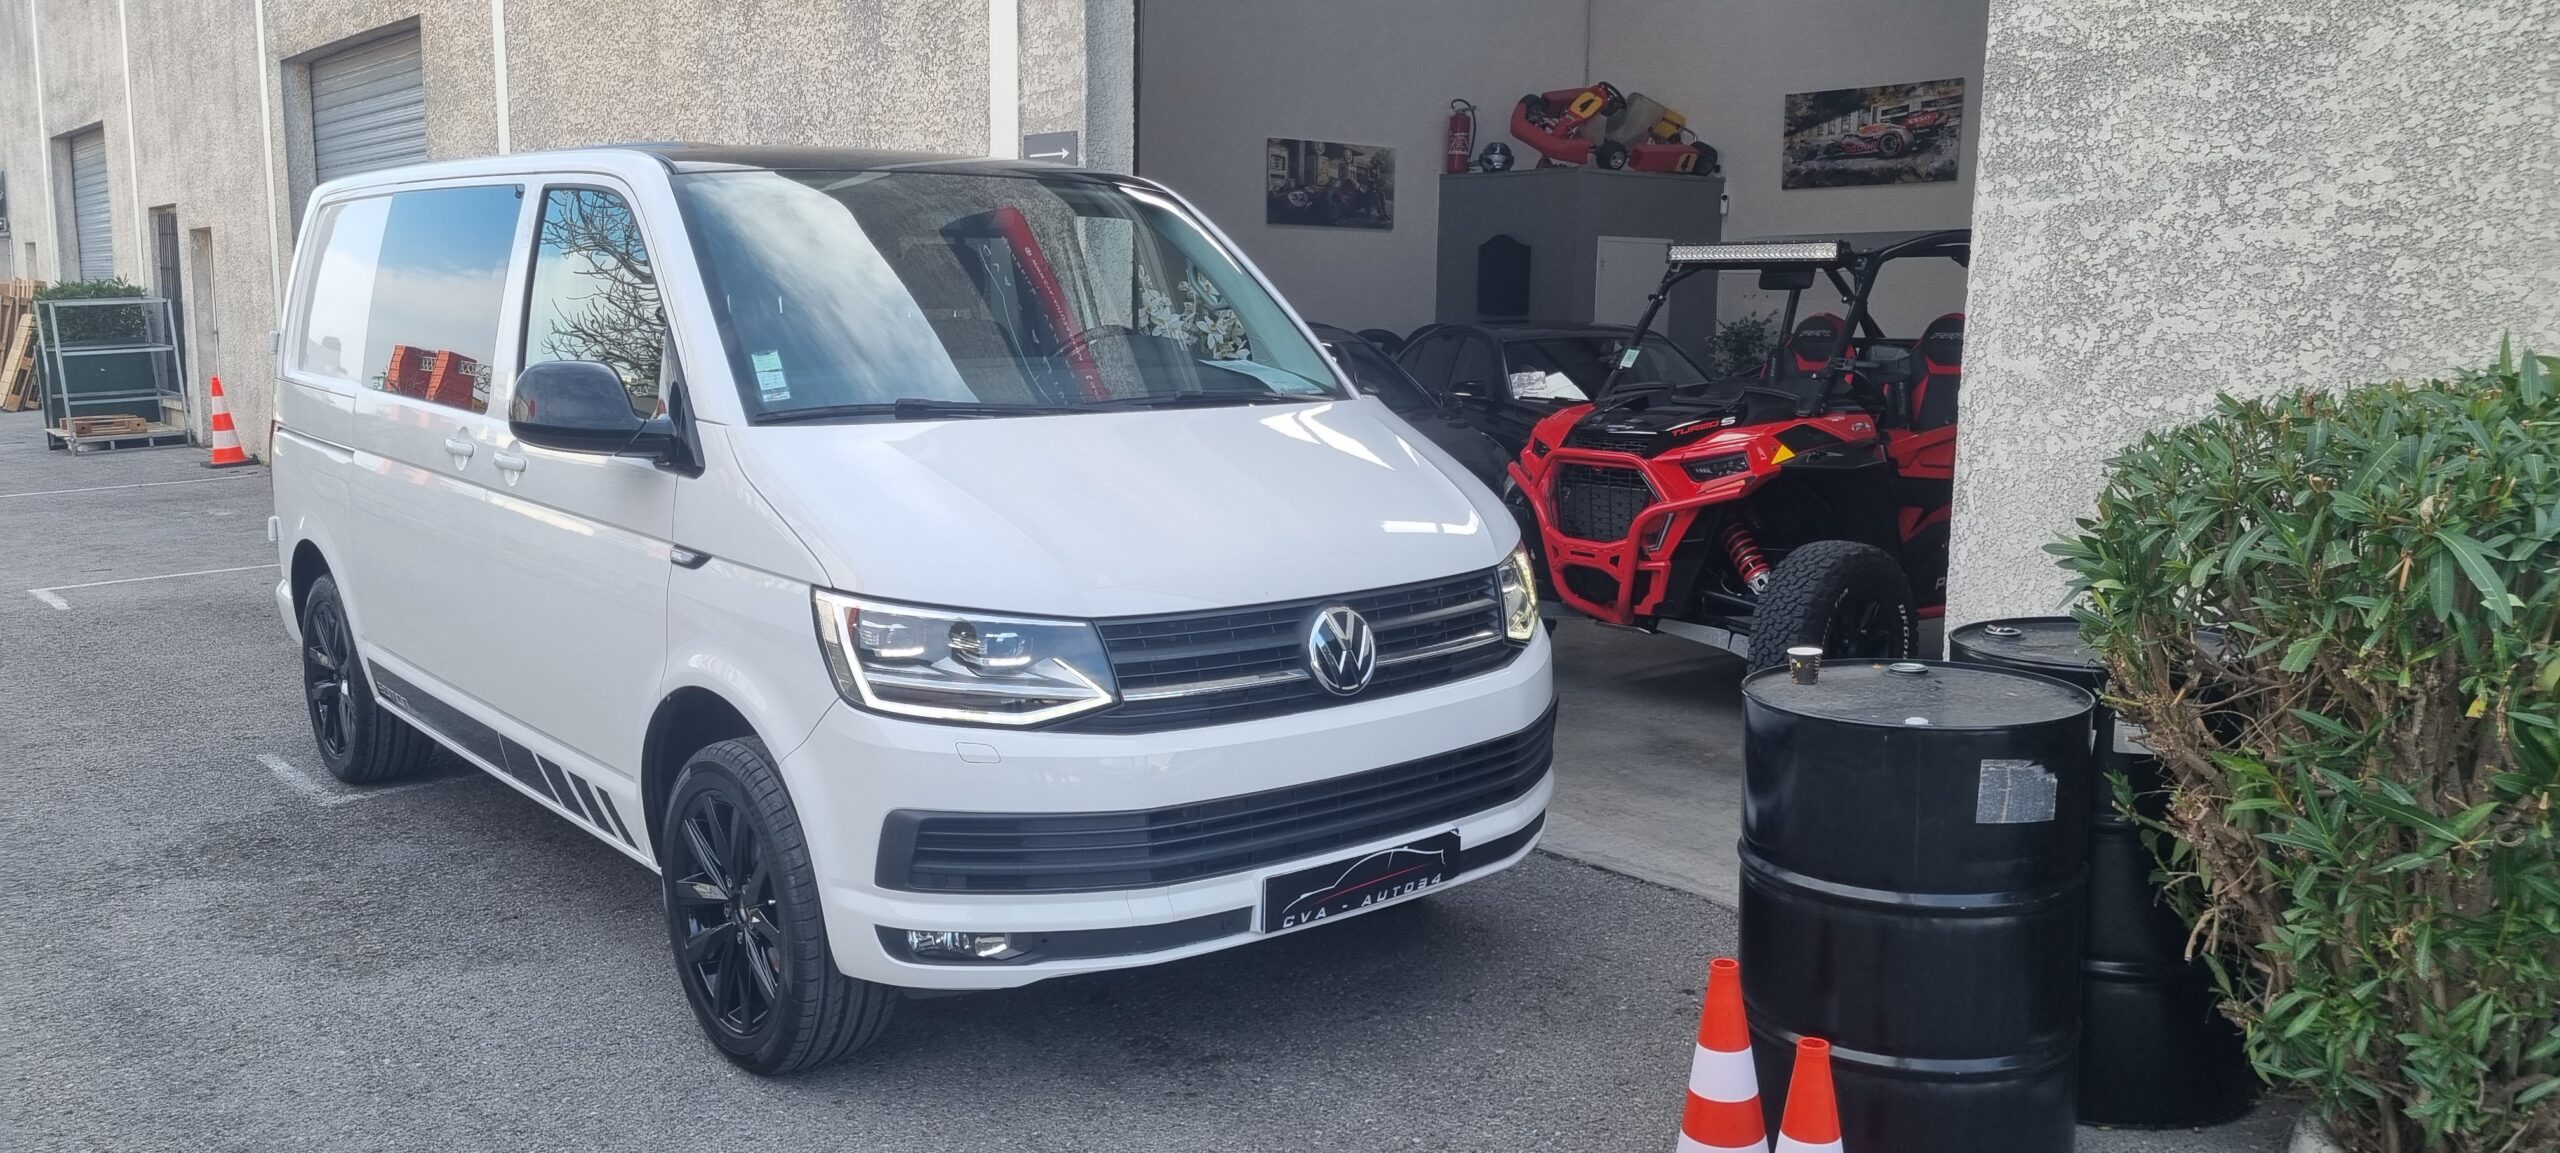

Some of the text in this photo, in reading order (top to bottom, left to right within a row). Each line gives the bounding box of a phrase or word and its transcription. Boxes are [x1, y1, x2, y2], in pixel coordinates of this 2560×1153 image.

[1672, 416, 1736, 437] TURBO S
[1282, 907, 1327, 929] CVA
[1361, 873, 1442, 907] AUTO34
